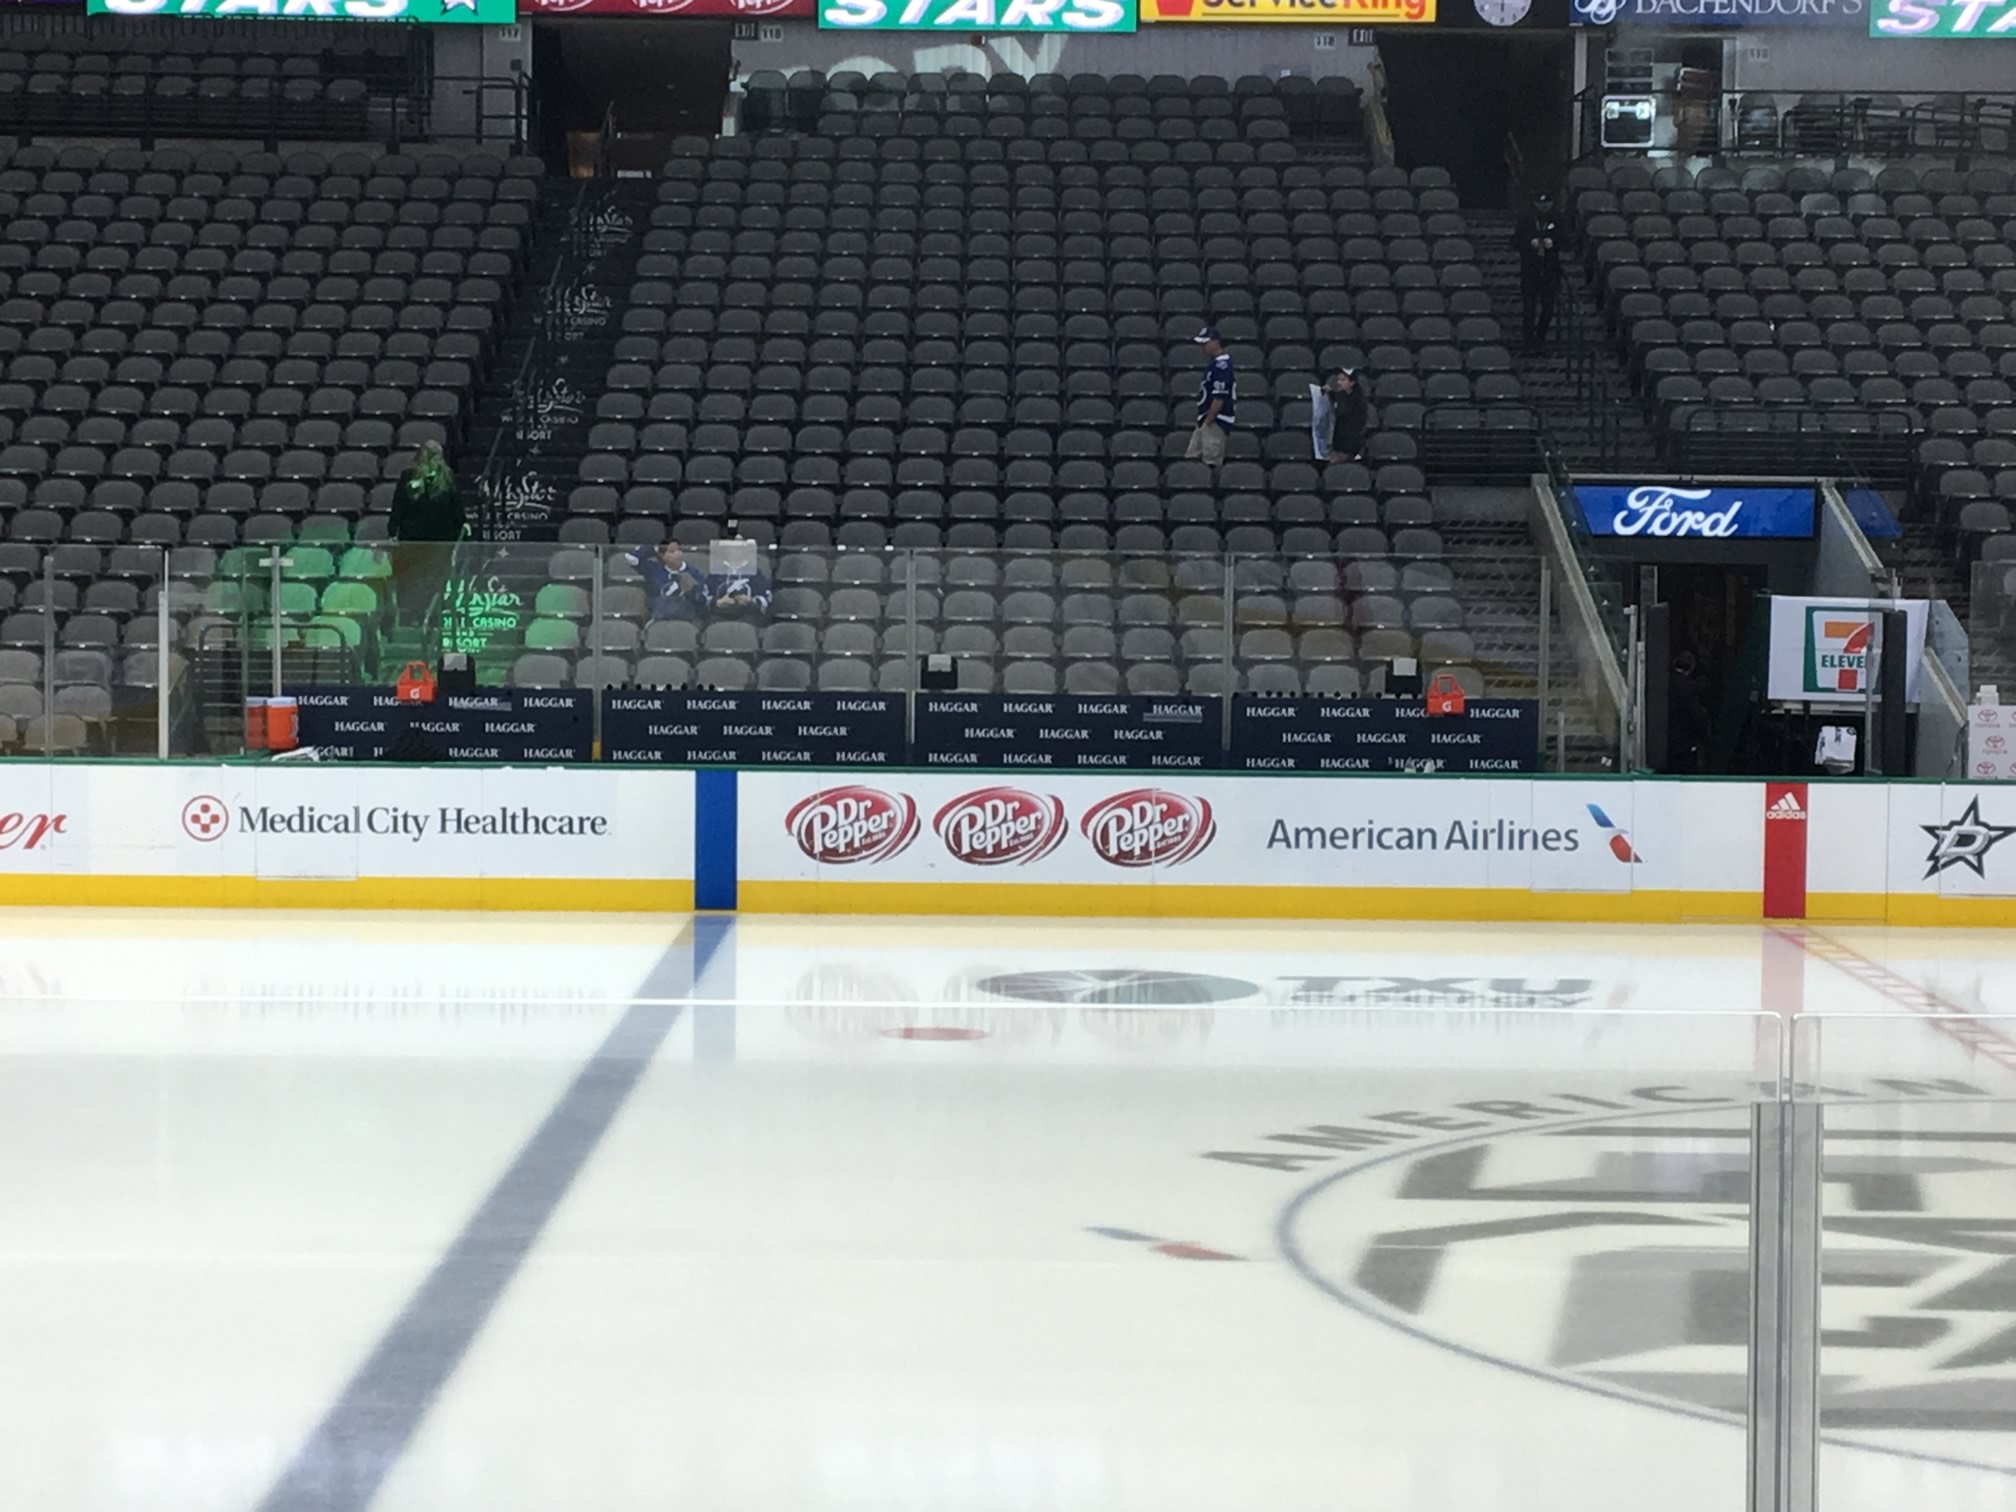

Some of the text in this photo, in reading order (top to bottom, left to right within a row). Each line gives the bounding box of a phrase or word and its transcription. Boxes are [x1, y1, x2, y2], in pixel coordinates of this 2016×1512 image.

[825, 0, 1125, 28] STARS
[1613, 485, 1743, 537] Ford
[472, 616, 517, 628] CASINO
[1821, 654, 1866, 668] ELEVE
[1823, 620, 1875, 689] 7
[296, 695, 348, 706] HAGGAR
[523, 697, 574, 708] HAGGAR
[611, 699, 886, 711] HAGGAR HAGGAR HAGGAR HAGGAR
[928, 702, 1202, 715] HAGGAR HAGGAR HAGGAR HAGGAR
[1246, 707, 1296, 717] HAGGAR
[1320, 707, 1370, 718] HAGGAR
[1470, 708, 1520, 718] HAGGAR
[334, 721, 385, 732] HAGGAR
[485, 722, 535, 733] HAGGAR
[648, 725, 847, 736] HAGGAR HAGGAR HAGGAR
[964, 728, 1163, 740] HAGGAR HAGGAR HAGGAR
[1282, 733, 1481, 743] HAGGAR HAGGAR HAGGAR
[448, 748, 499, 758] HAGGAR
[523, 748, 573, 758] HAGGAR
[612, 750, 885, 762] HAGGAR HAGGAR HAGGAR HAGGAR
[928, 753, 1201, 765] HAGGAR HAGGAR HAGGAR HAGGAR
[1246, 758, 1295, 768] HAGGAR
[1320, 758, 1369, 768] HAGGAR
[1469, 759, 1518, 769] HAGGAR
[836, 797, 873, 828] Dr
[984, 798, 1021, 828] Dr
[1131, 801, 1168, 829] Dr
[1766, 809, 1807, 821] adidas
[238, 805, 608, 843] Medical City Healthcare
[812, 804, 895, 855] Pepper
[959, 806, 1042, 855] Pepper
[1106, 808, 1190, 857] Pepper
[1266, 818, 1579, 853] American Airlines
[1276, 976, 1593, 994] TXU
